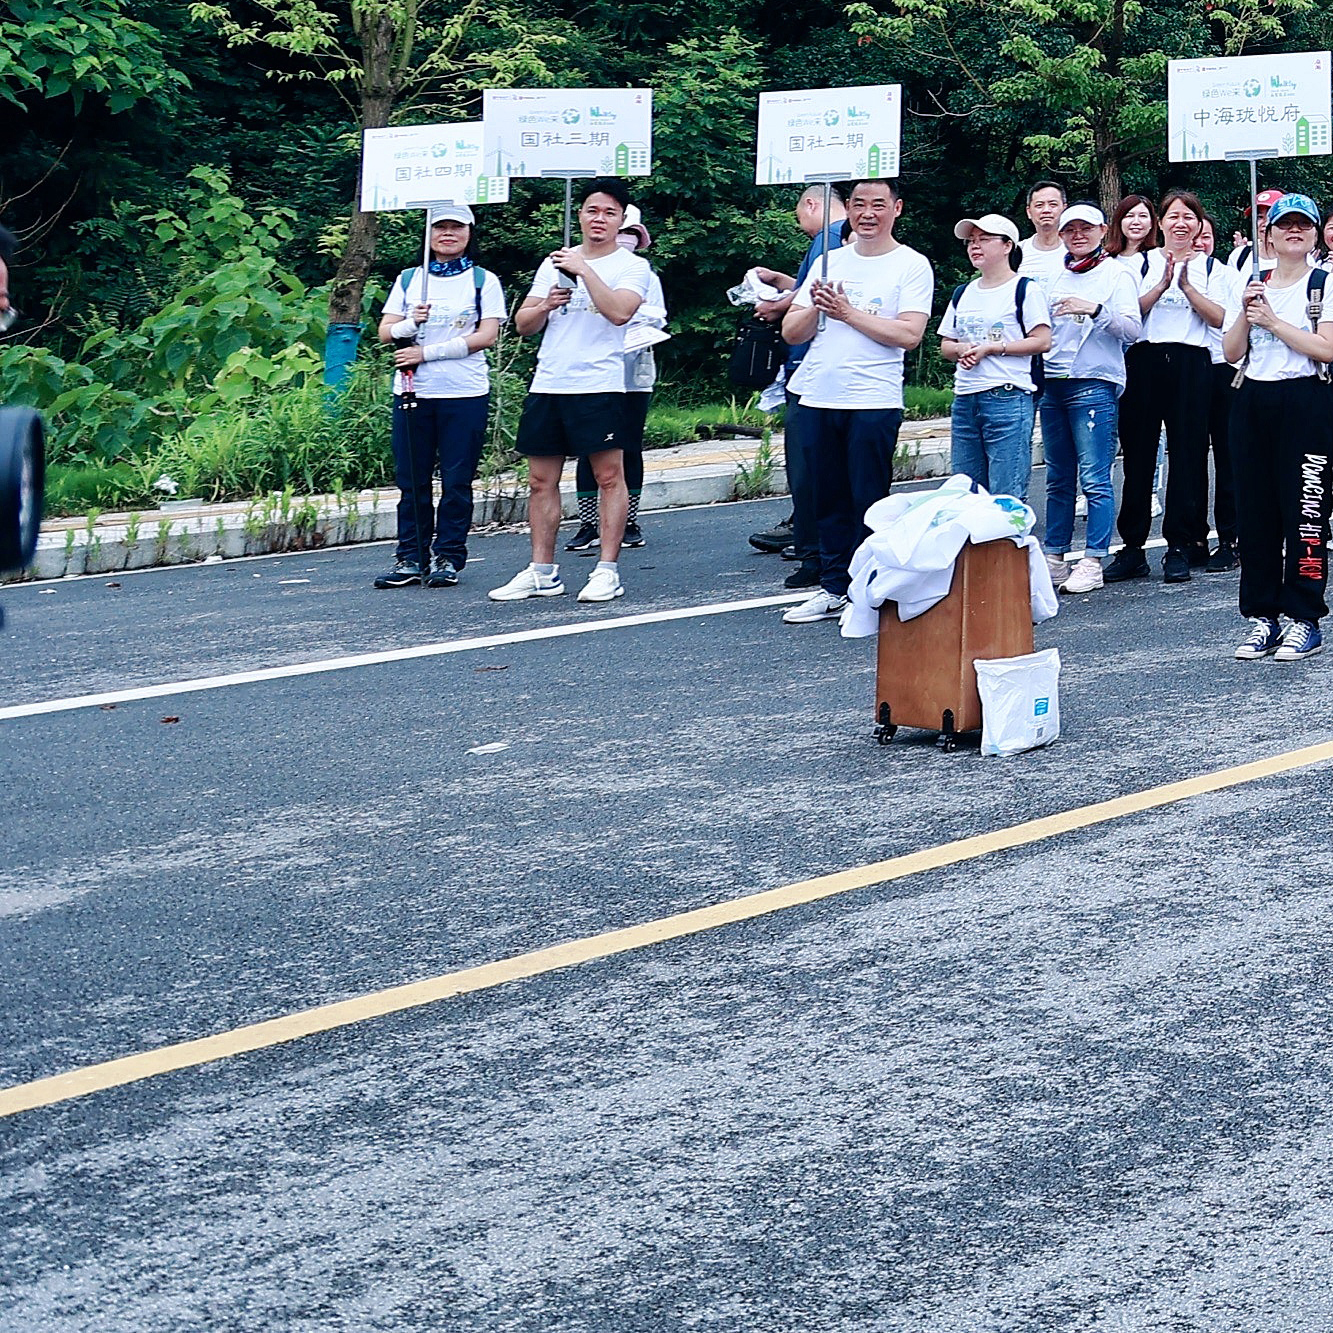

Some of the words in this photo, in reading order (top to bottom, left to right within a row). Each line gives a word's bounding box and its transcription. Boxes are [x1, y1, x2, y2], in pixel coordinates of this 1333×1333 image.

[1193, 103, 1301, 128] 中海珑悦府
[520, 131, 610, 148] 国社三期
[788, 132, 864, 153] 国社二期
[395, 163, 473, 182] 国社四期
